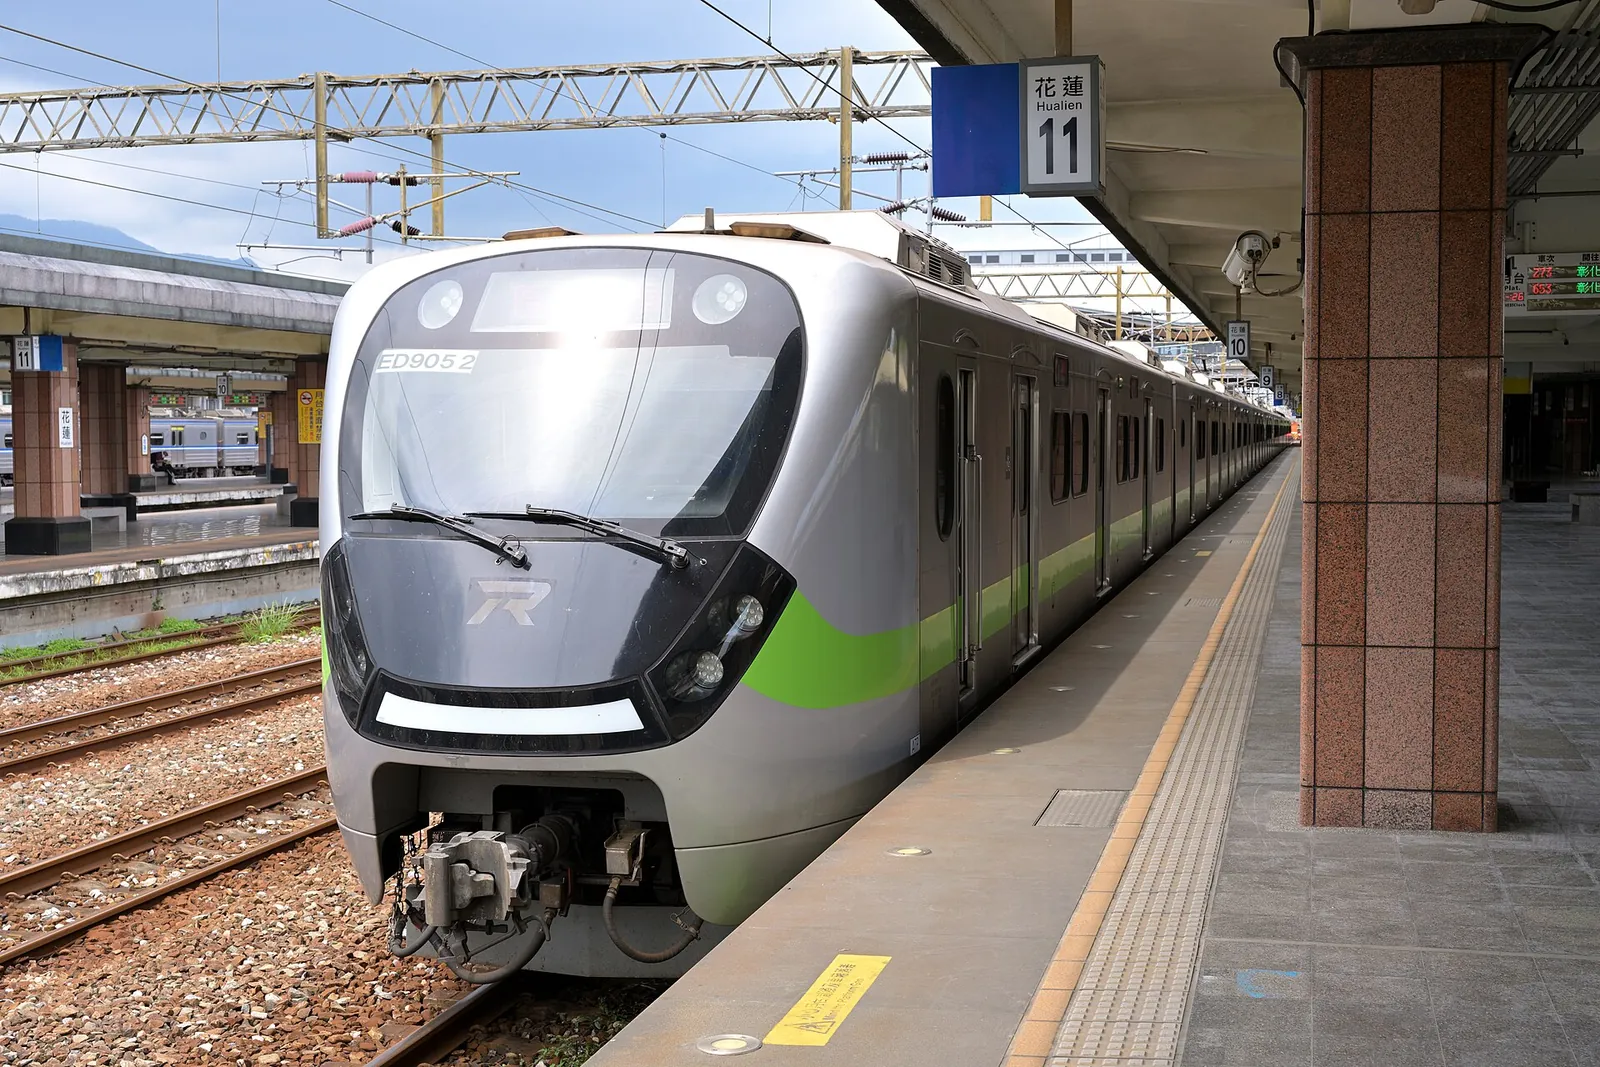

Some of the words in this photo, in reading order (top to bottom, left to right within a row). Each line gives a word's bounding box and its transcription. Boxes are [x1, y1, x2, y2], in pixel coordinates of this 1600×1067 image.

[1035, 76, 1084, 98] 花蓮
[1037, 101, 1082, 111] Hualien
[1039, 117, 1077, 174] 11
[1538, 254, 1555, 262] 車次
[1533, 267, 1552, 277] 273
[1577, 265, 1600, 277] 彰化
[1533, 284, 1552, 294] 653
[1577, 282, 1600, 293] 彰化
[1231, 339, 1245, 355] 10
[18, 351, 29, 367] 11
[377, 353, 476, 370] ED9052
[1263, 375, 1271, 386] 9
[218, 384, 226, 394] 10
[1277, 391, 1283, 399] 8
[61, 410, 71, 439] 花蓮
